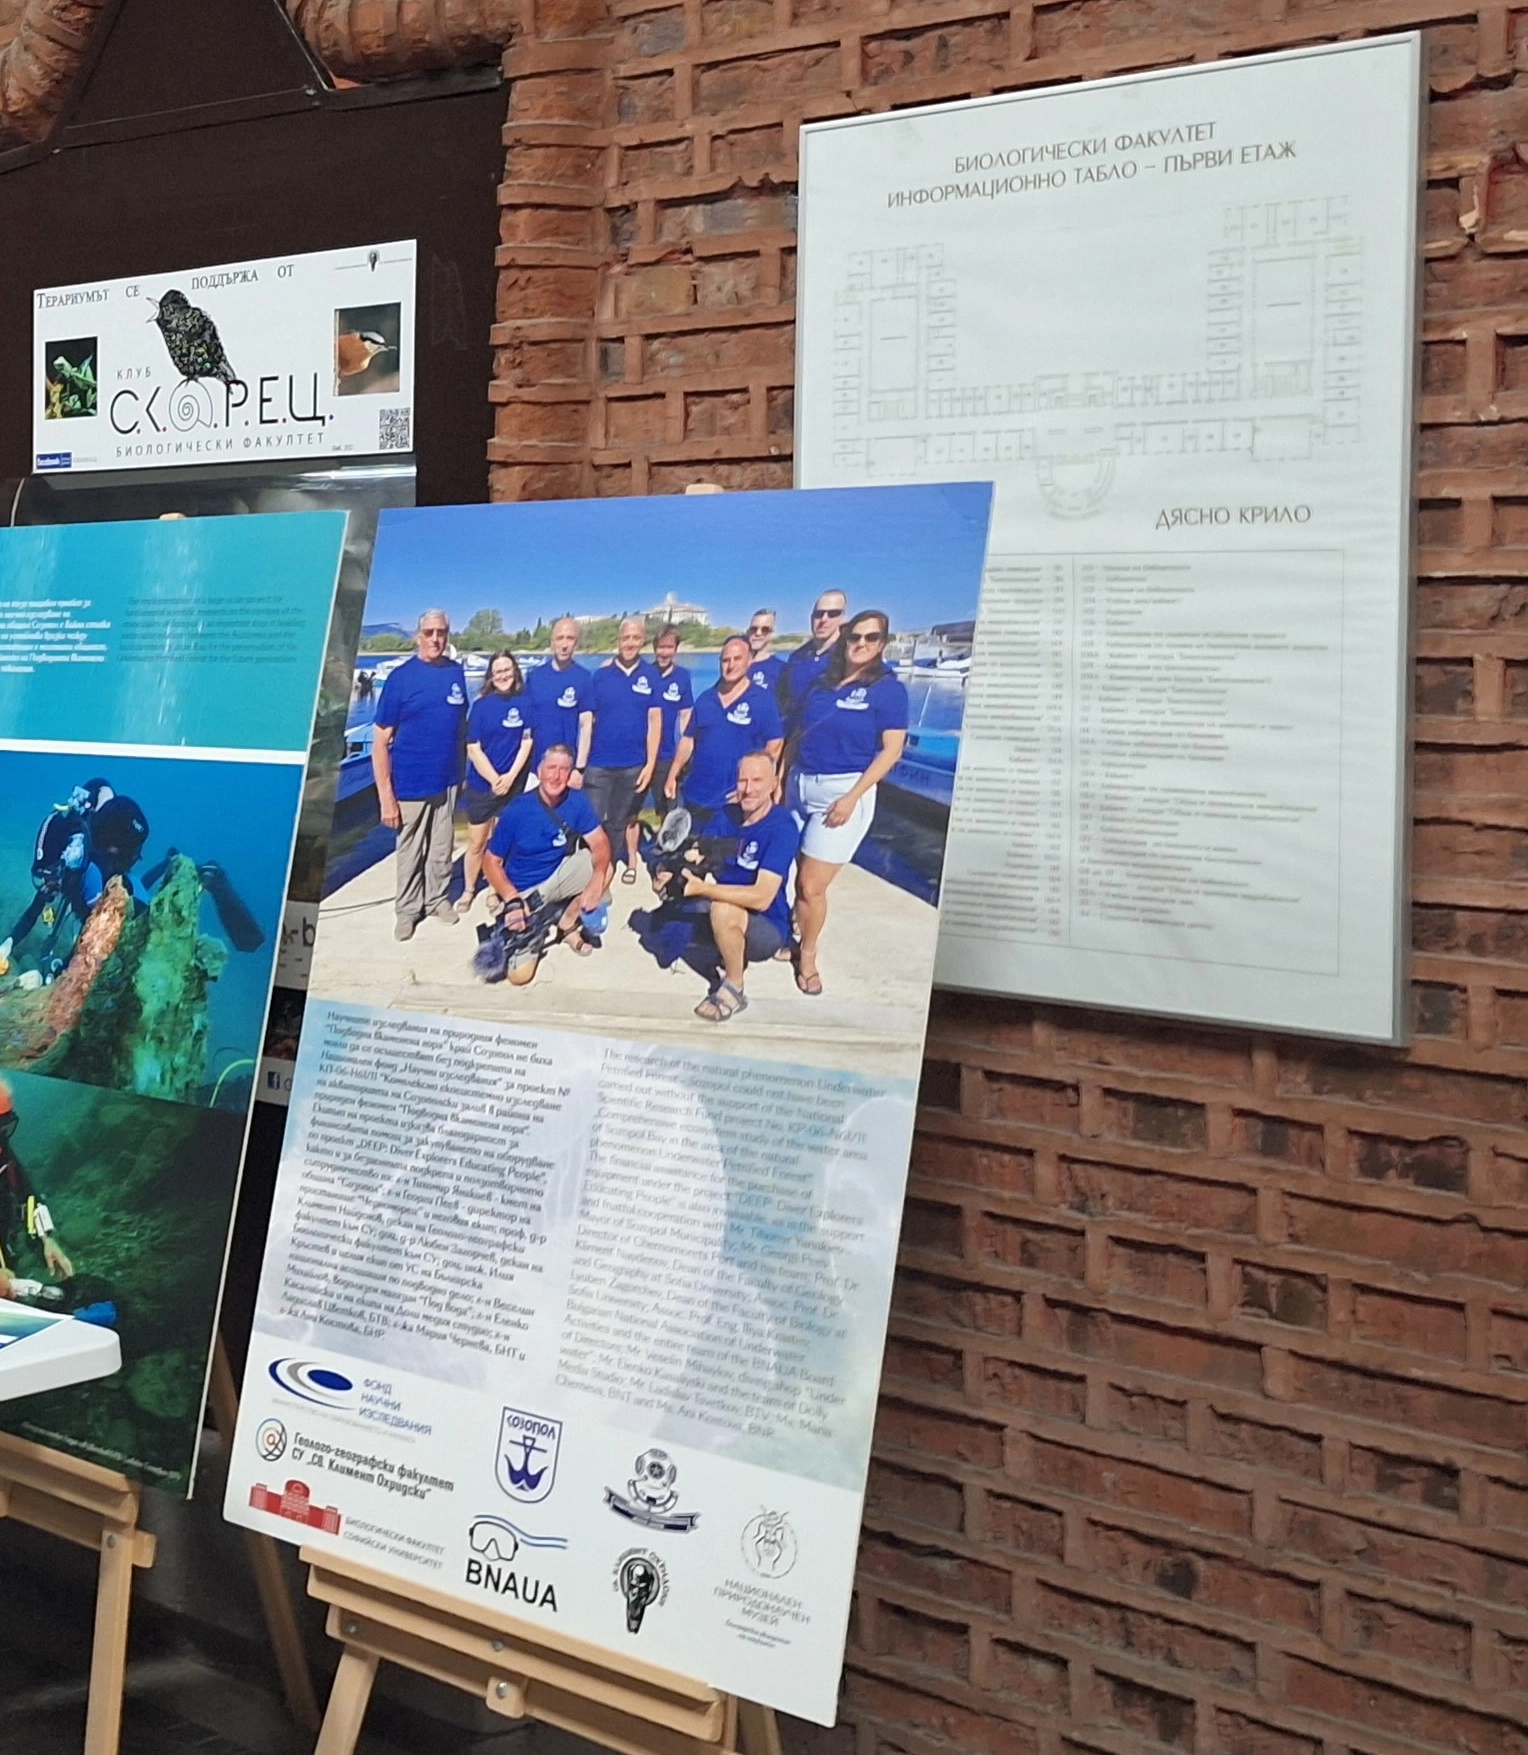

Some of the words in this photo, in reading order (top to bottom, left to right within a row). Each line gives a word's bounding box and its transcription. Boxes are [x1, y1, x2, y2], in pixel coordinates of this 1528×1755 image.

[954, 137, 1107, 174] БИОЛОГИЧЕСКИ
[1114, 121, 1217, 152] ФАКУЛТЕТ
[887, 170, 1067, 208] ИНФОРМАЦИОННО
[1074, 160, 1138, 184] ТАБЛО
[1164, 148, 1233, 174] ПЪРВИ
[1240, 140, 1297, 165] ЕТАЖ
[276, 264, 295, 279] ОТ
[116, 366, 153, 381] КЛУБ
[115, 438, 234, 459] БИОЛОГИЧЕСКИ
[242, 431, 325, 449] ФАКУЛТЕТ
[1155, 507, 1230, 531] ДЯСНО
[1239, 505, 1311, 524] КРИЛО
[429, 1027, 441, 1036] на
[449, 1041, 472, 1055] край
[473, 1045, 514, 1060] Созопол
[503, 1081, 515, 1092] за
[516, 1083, 556, 1096] проект
[459, 1156, 506, 1178] Educating
[363, 1378, 393, 1395] ФОНД
[361, 1392, 402, 1413] НАУЧНИ
[358, 1407, 433, 1436] ИЗСЛЕДВАНИЯ
[291, 1447, 305, 1462] СУ
[327, 1460, 375, 1484] Климент
[293, 1431, 396, 1475] Геолого-географски
[396, 1464, 455, 1493] факултет
[465, 1557, 559, 1613] BNAUA
